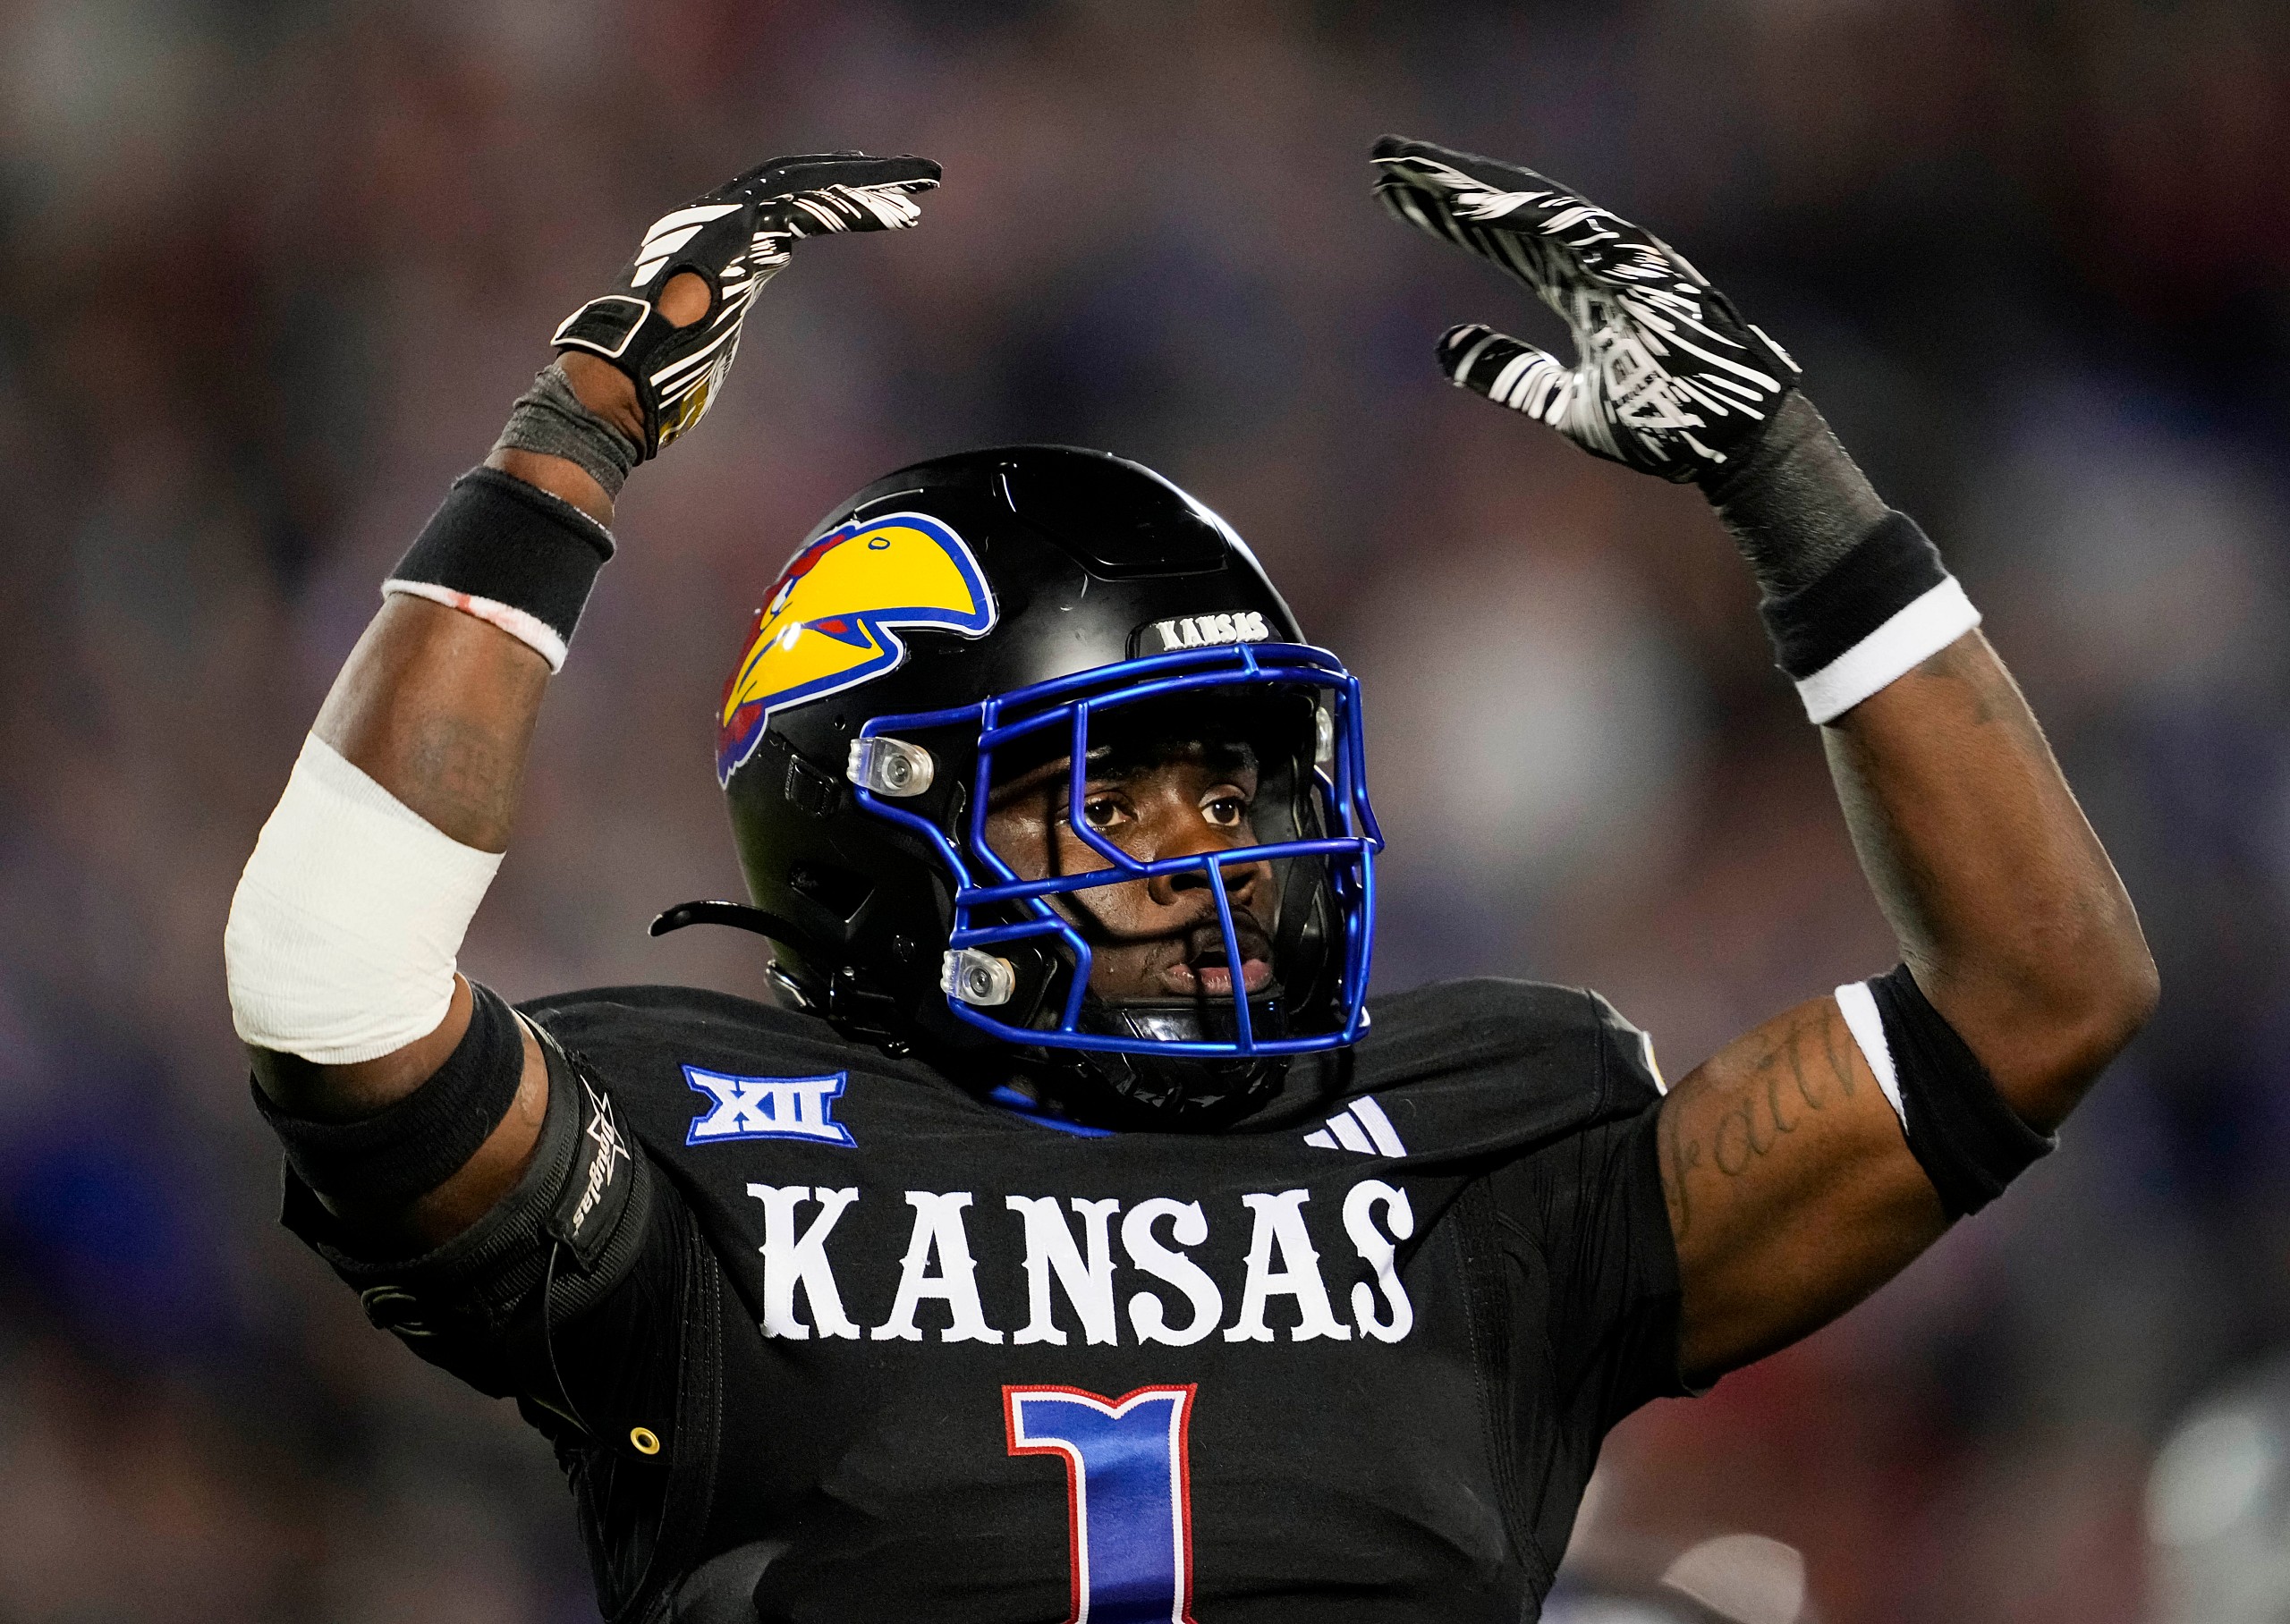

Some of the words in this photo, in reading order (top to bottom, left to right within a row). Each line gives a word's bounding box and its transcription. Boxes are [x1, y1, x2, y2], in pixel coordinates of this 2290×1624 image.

[1156, 611, 1269, 652] KANSAS
[686, 1069, 846, 1139] XII
[572, 1111, 615, 1229] Douglas
[746, 1179, 1414, 1347] KANSAS
[1002, 1383, 1198, 1624] 1
